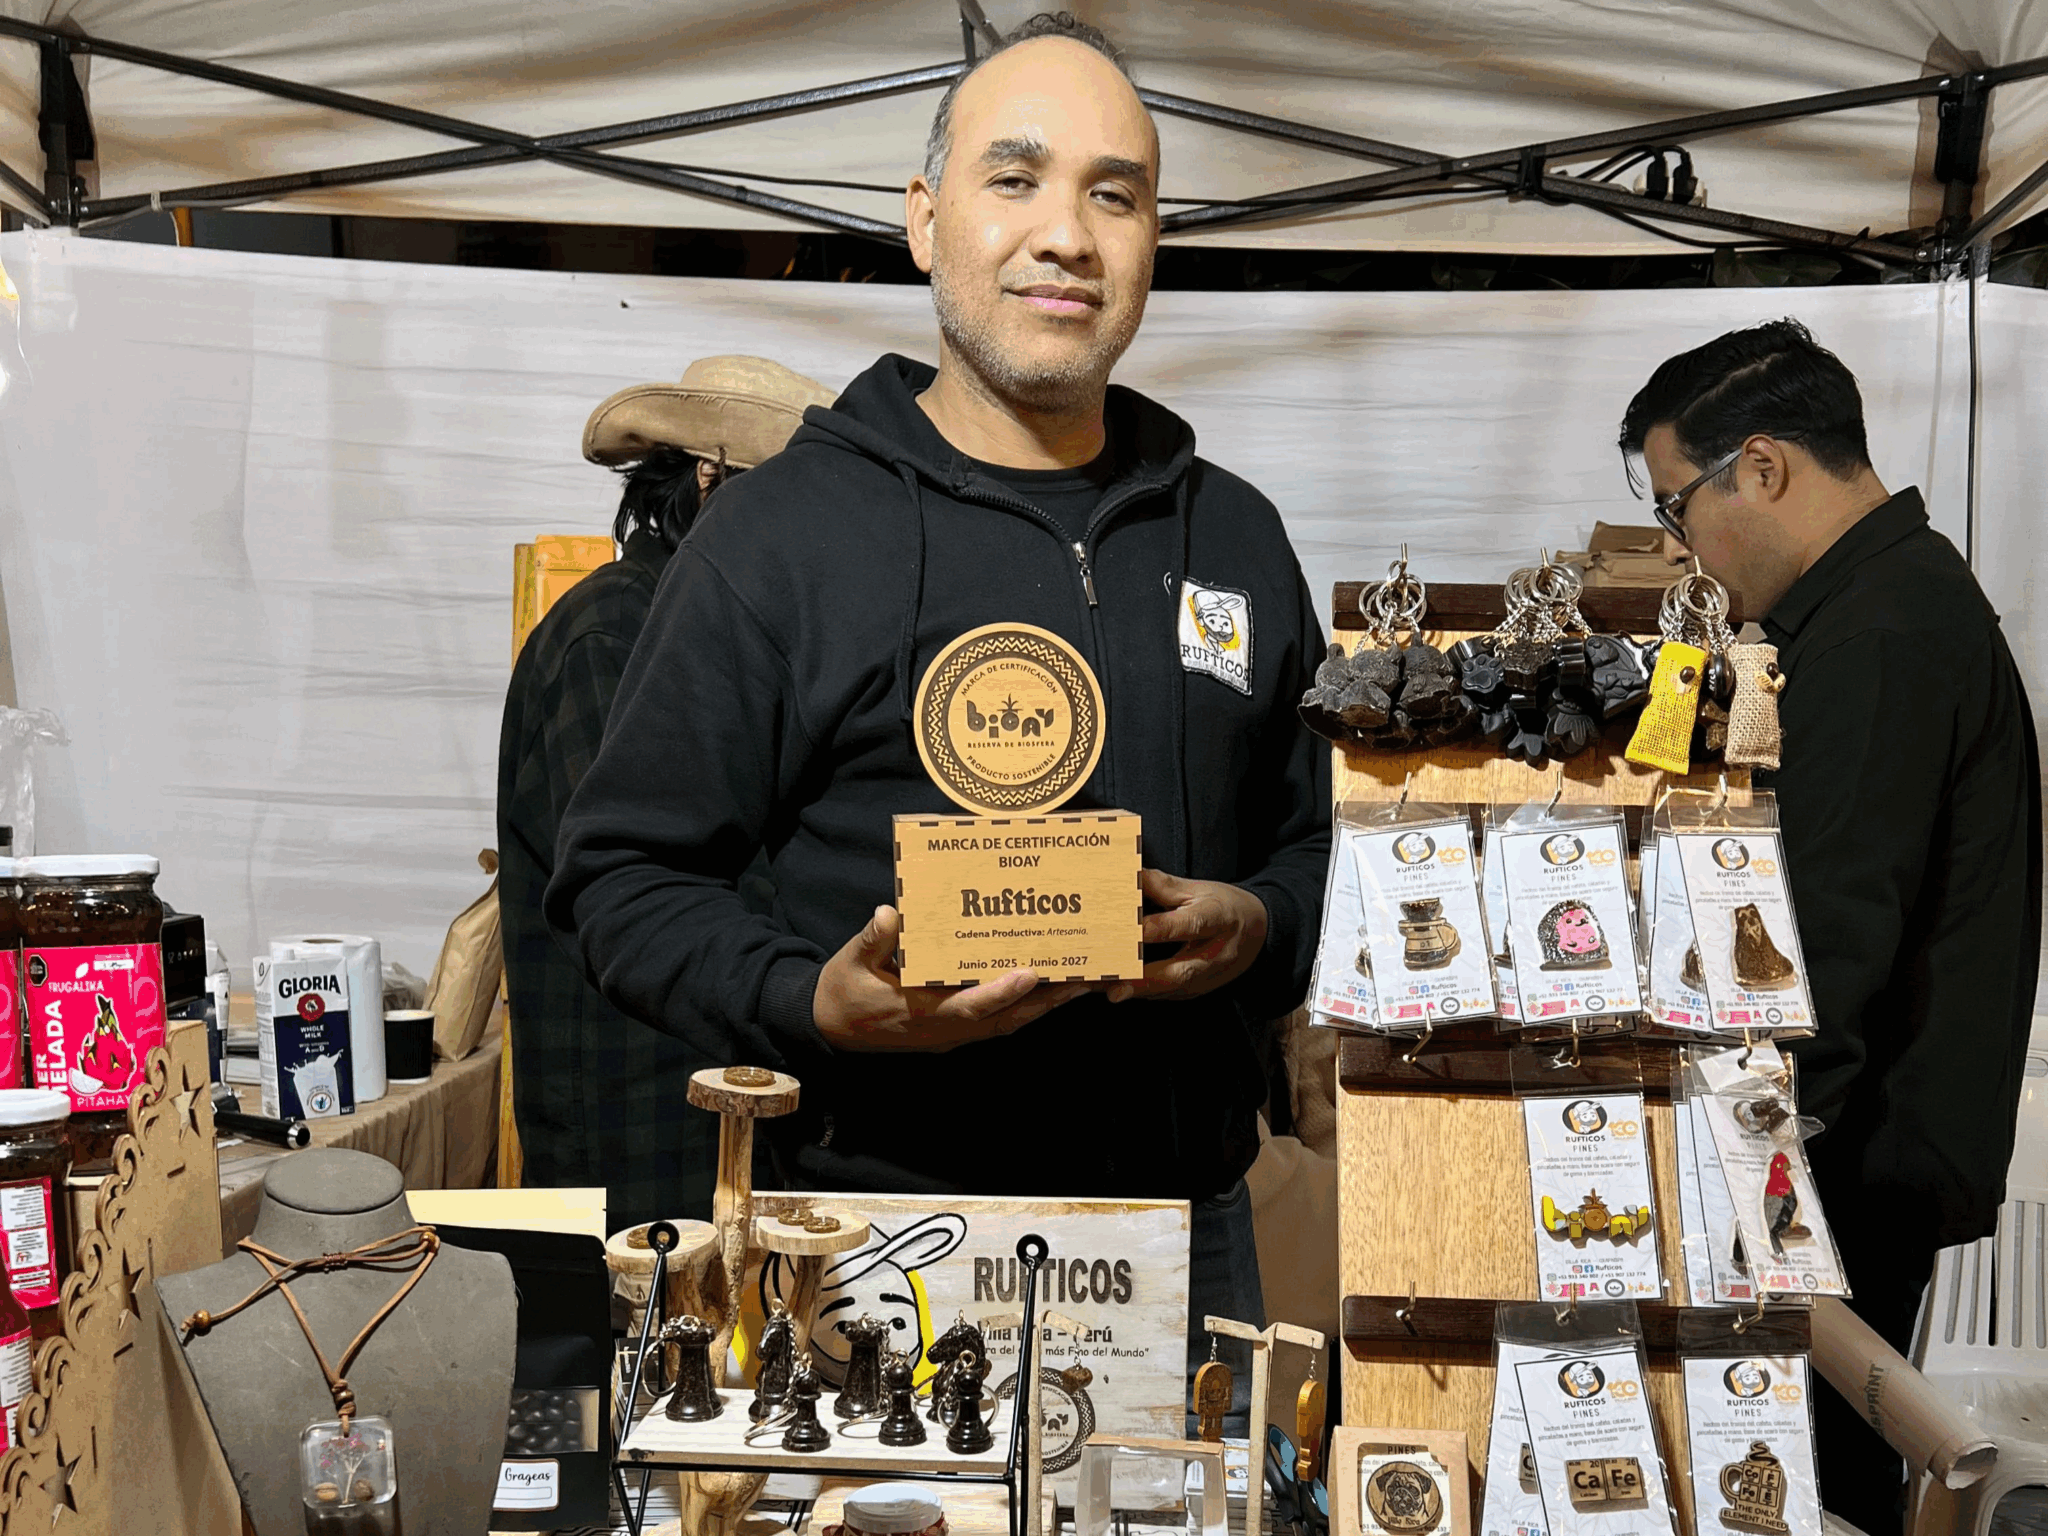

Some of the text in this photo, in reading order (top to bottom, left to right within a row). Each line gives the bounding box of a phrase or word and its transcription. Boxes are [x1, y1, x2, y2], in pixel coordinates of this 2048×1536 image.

[1181, 644, 1248, 680] RUFTICOS
[961, 663, 1058, 696] MARCA DE CERTIFICACIÓN
[967, 753, 1056, 780] PRODUCTO SOSTENIBLE
[927, 832, 1110, 851] MARCA DE CERTIFICACIÓN
[999, 855, 1041, 868] BIOAY
[1396, 863, 1435, 873] RUFTICOS
[1543, 864, 1584, 874] RUFTICOS
[1403, 873, 1429, 882] PINES
[1551, 874, 1577, 882] PINES
[1716, 871, 1750, 879] RUFTICOS
[1724, 879, 1746, 887] PINES
[960, 887, 1082, 917] Rufticos
[955, 930, 990, 939] Cadena
[991, 928, 1045, 938] Productiva:
[958, 960, 988, 969] Junio
[991, 959, 1017, 968] 2025
[1029, 957, 1059, 968] Junio
[1061, 956, 1089, 966] 2027
[278, 975, 342, 999] GLORIA
[300, 1024, 324, 1033] WHOLE
[77, 1094, 130, 1107] PITAHAY
[1565, 1134, 1606, 1143] RUFTICOS
[1572, 1143, 1598, 1153] PINES
[1073, 1326, 1112, 1342] erú
[1045, 1347, 1065, 1356] más
[1068, 1347, 1089, 1357] Fno
[1092, 1346, 1107, 1356] del
[1564, 1398, 1606, 1409] RUFTICOS
[1727, 1399, 1770, 1407] RUFTICOS
[1573, 1408, 1600, 1419] PINES
[1735, 1409, 1762, 1417] PINES
[1387, 1445, 1416, 1455] PINES
[1589, 1460, 1600, 1468] 20
[1626, 1458, 1636, 1466] 26
[505, 1467, 551, 1486] Grageas
[1573, 1471, 1601, 1489] Ca
[1611, 1469, 1636, 1487] Fe
[1738, 1503, 1776, 1518] THE ONLY
[1724, 1510, 1761, 1524] ELEMENT
[1765, 1518, 1787, 1529] NEED
